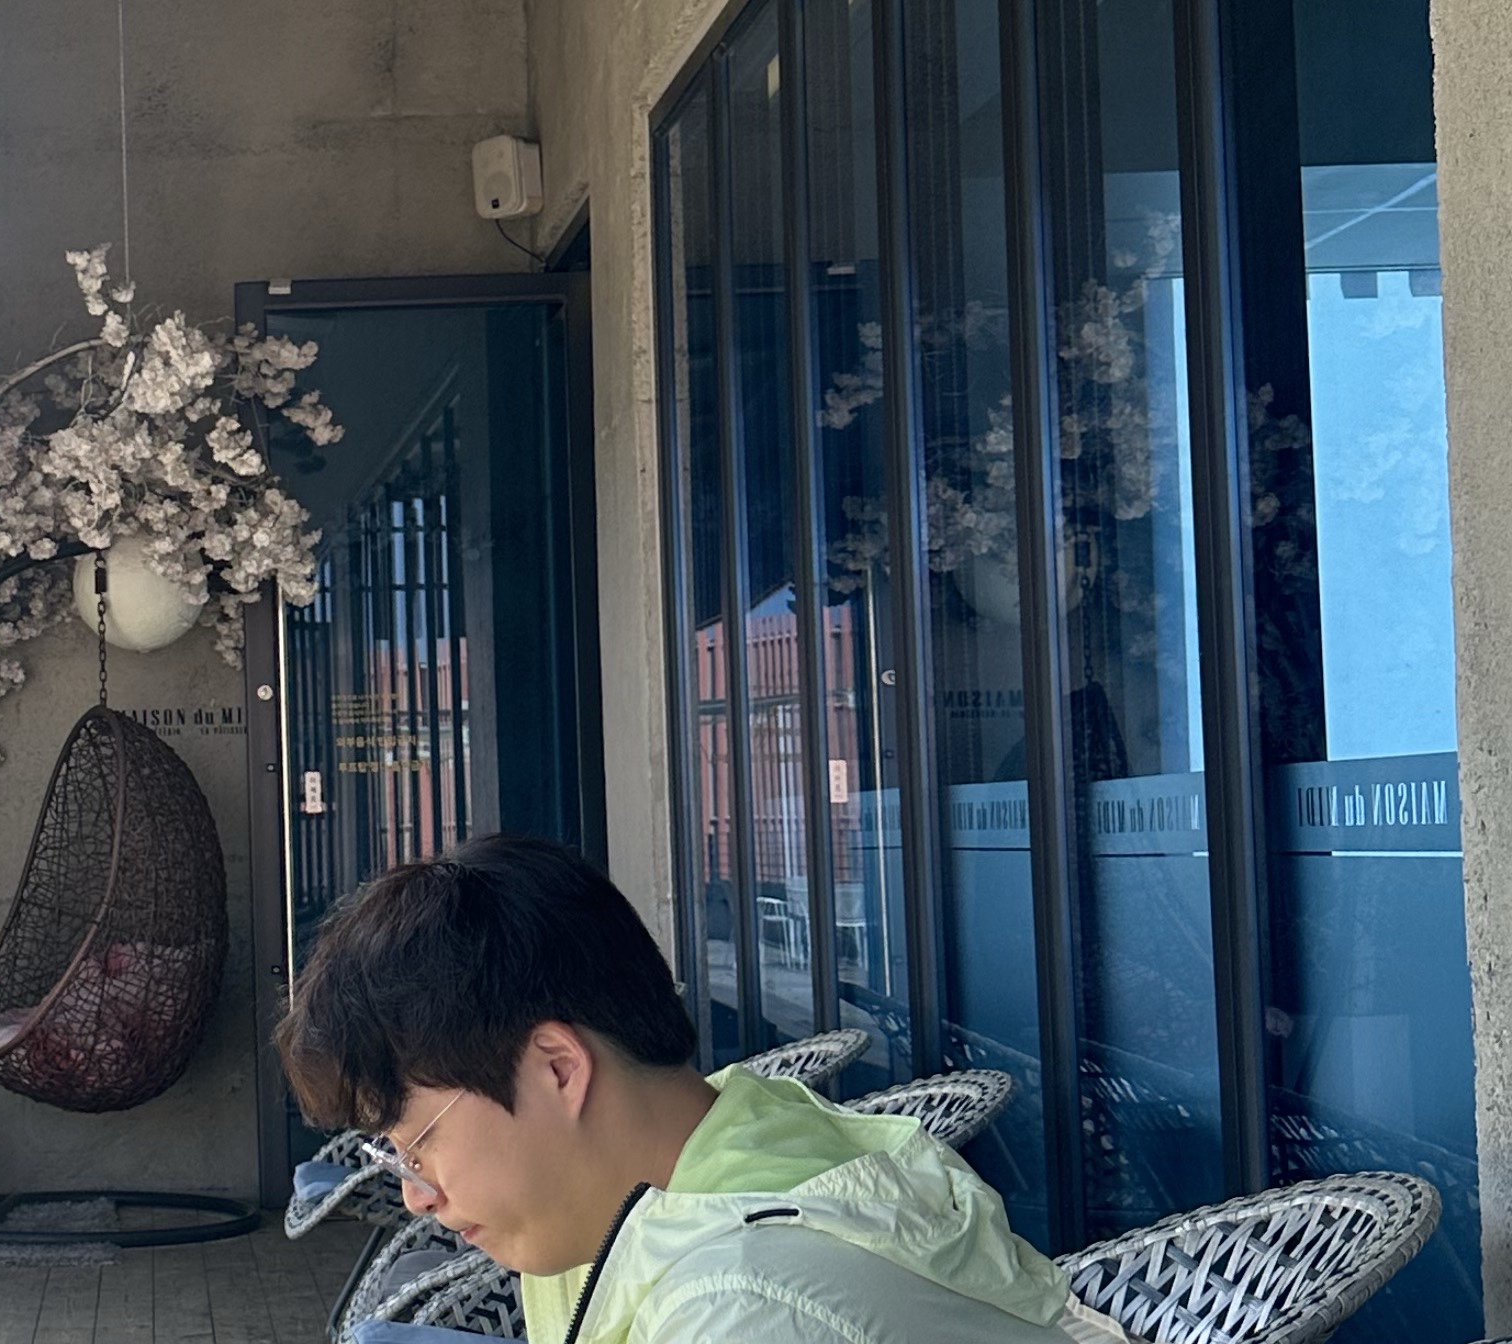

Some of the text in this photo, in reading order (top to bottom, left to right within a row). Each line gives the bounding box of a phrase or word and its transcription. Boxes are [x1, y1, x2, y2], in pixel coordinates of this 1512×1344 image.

[122, 707, 242, 725] AISON du MI
